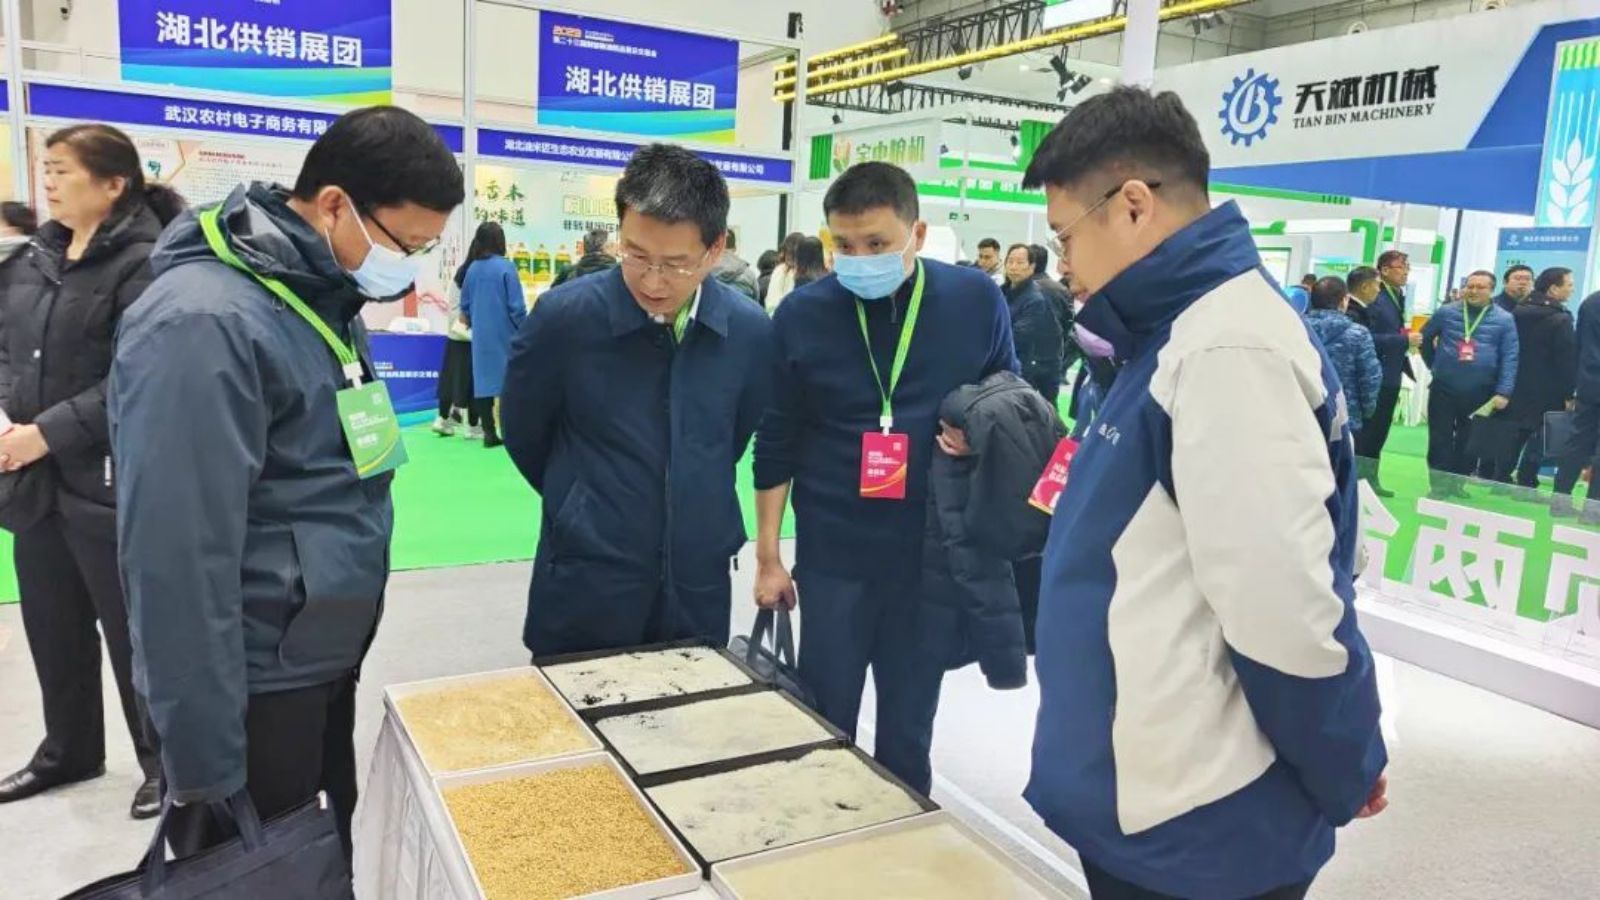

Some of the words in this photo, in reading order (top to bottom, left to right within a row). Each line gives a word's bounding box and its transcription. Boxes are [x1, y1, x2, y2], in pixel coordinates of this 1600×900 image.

[156, 11, 363, 67] 湖北供销展团
[565, 65, 716, 110] 湖北供销展团
[164, 105, 334, 136] 武汉农村电子商务有限
[1294, 115, 1322, 129] TIAN
[1324, 111, 1347, 126] BIN
[1350, 103, 1435, 124] MACHINERY
